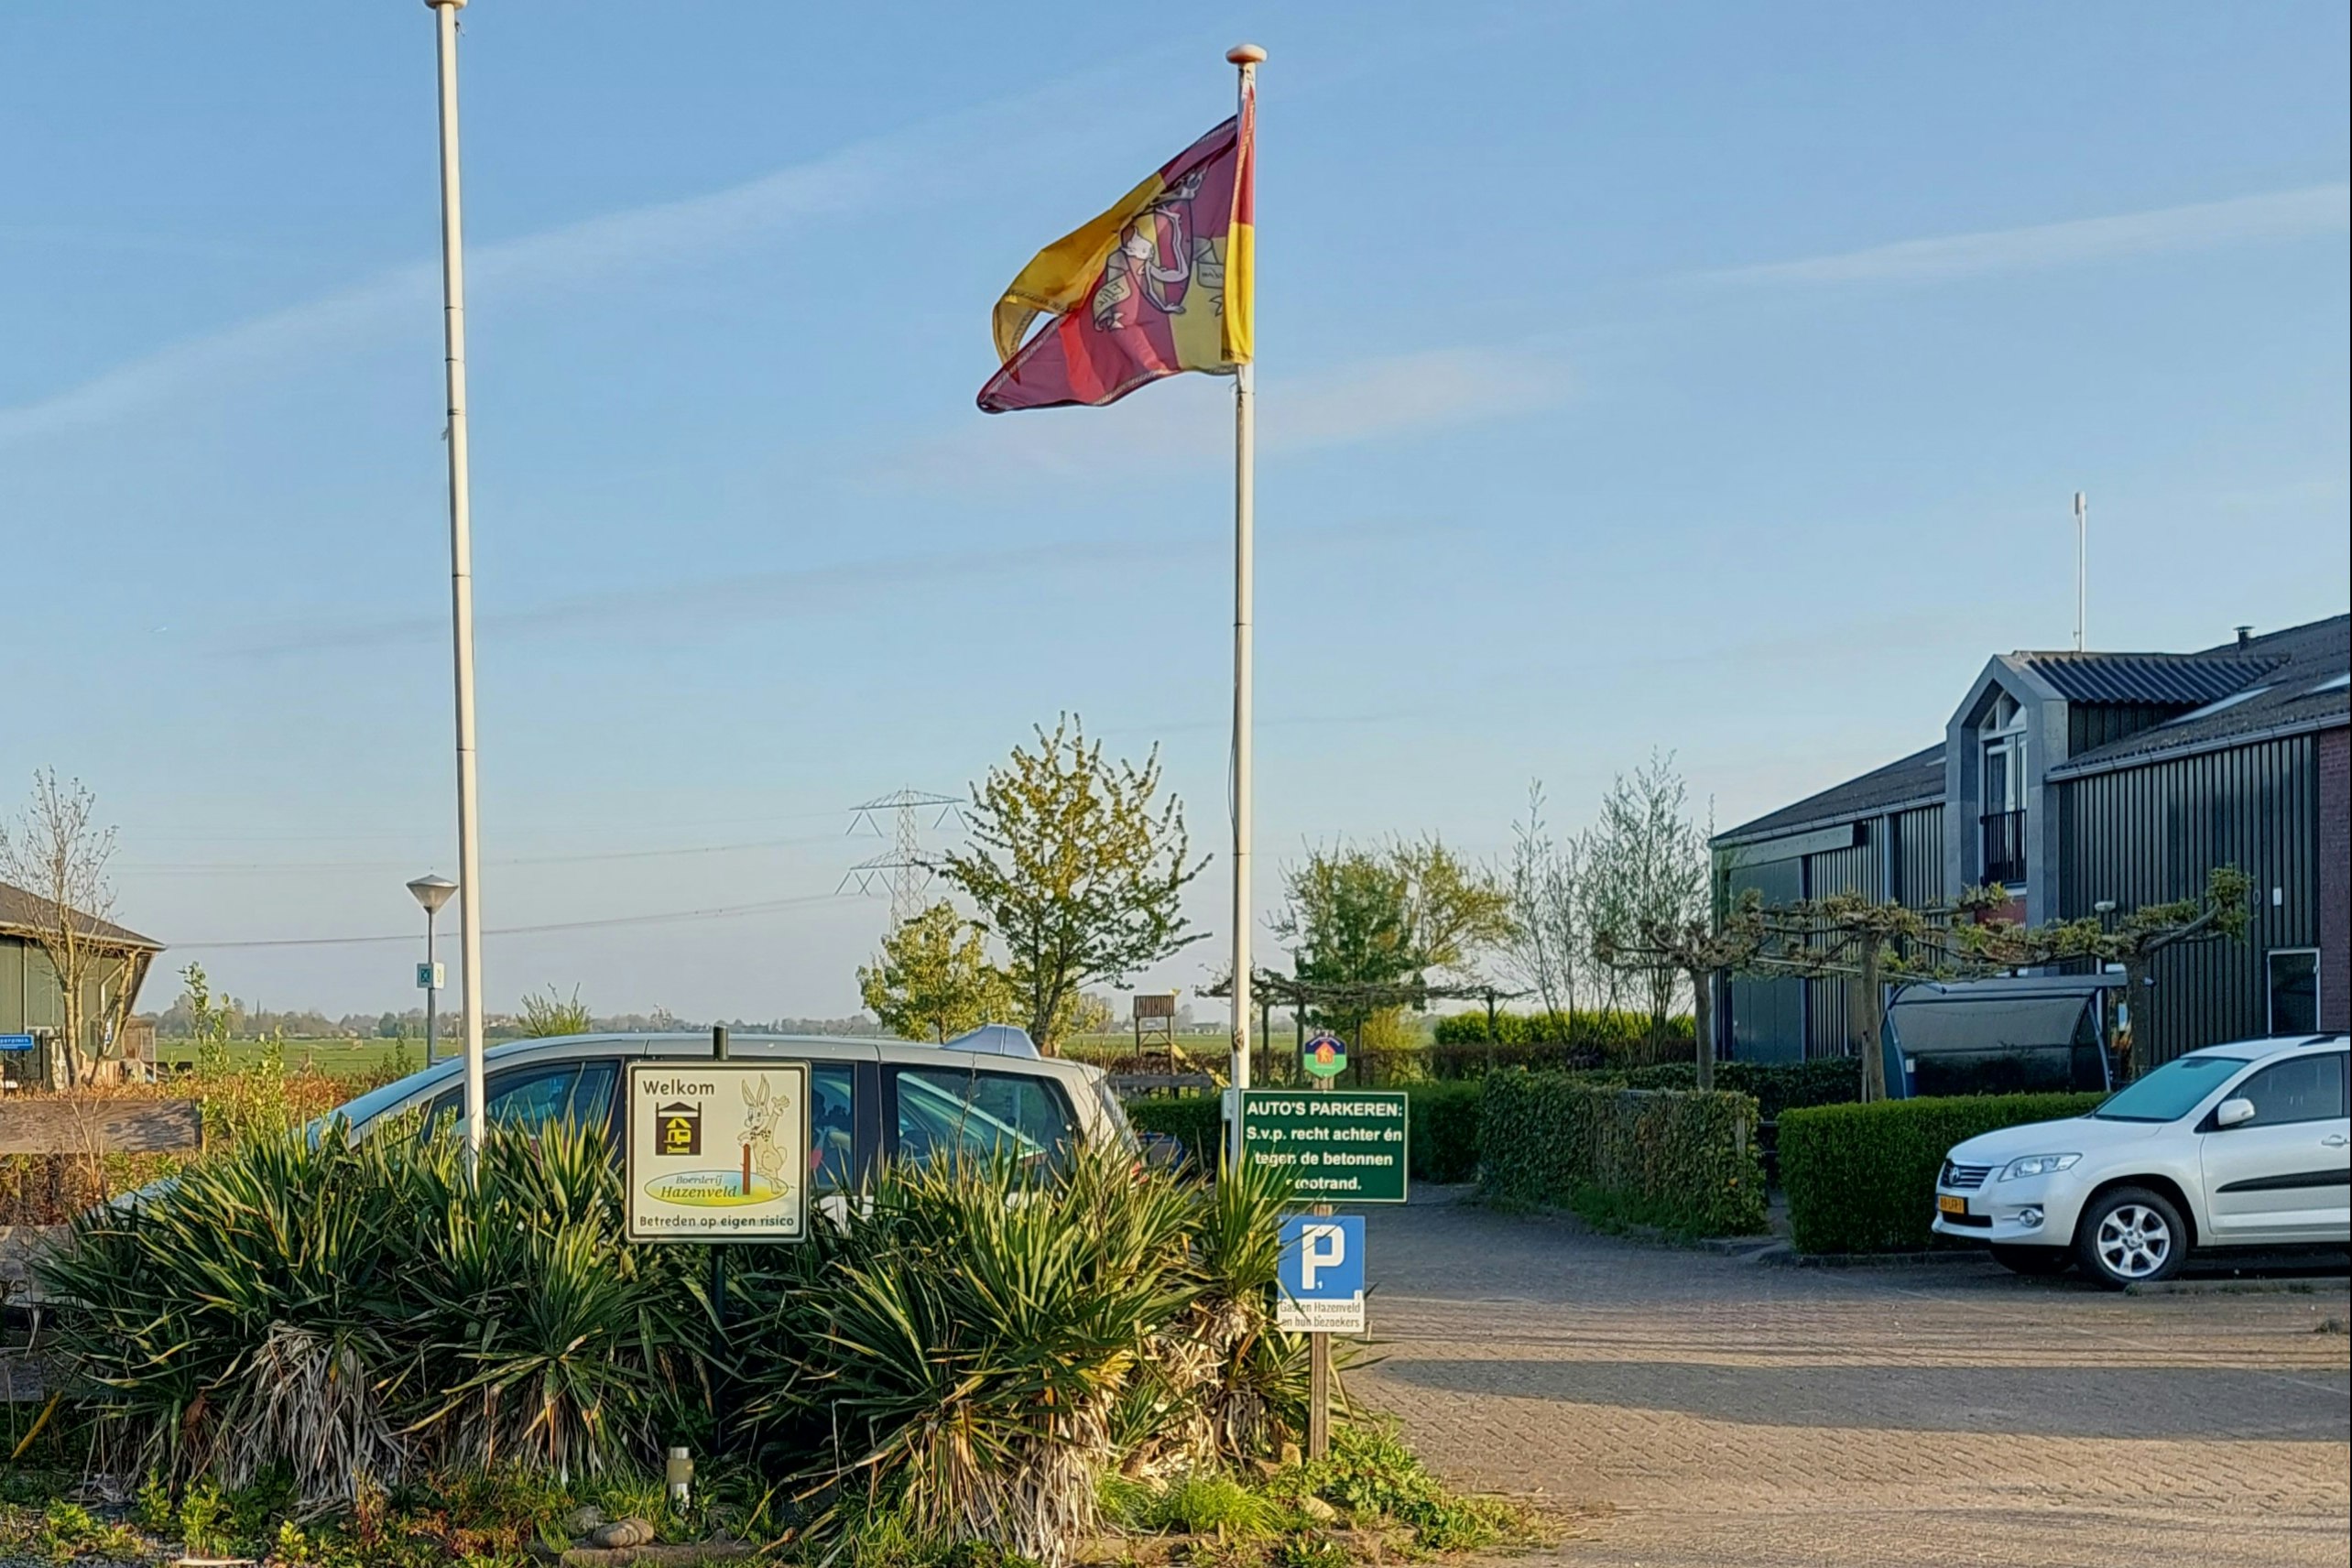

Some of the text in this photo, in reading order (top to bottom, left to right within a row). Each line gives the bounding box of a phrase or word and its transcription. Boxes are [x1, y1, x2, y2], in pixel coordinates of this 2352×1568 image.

[643, 1079, 714, 1095] Welkom
[1247, 1102, 1402, 1116] AUTO'S PARKEREN:
[1246, 1127, 1402, 1142] S.v.p. recht achter én
[1301, 1151, 1319, 1165] de
[1323, 1151, 1393, 1166] betonnen
[676, 1175, 723, 1186] Boerderij
[660, 1186, 737, 1198] Hazenveld
[639, 1214, 794, 1229] Betreden op eigen risico
[1302, 1224, 1345, 1290] P
[1279, 1301, 1361, 1313] Gasen Hazenveld
[1281, 1318, 1292, 1327] en
[1313, 1316, 1360, 1327] bezoekers
